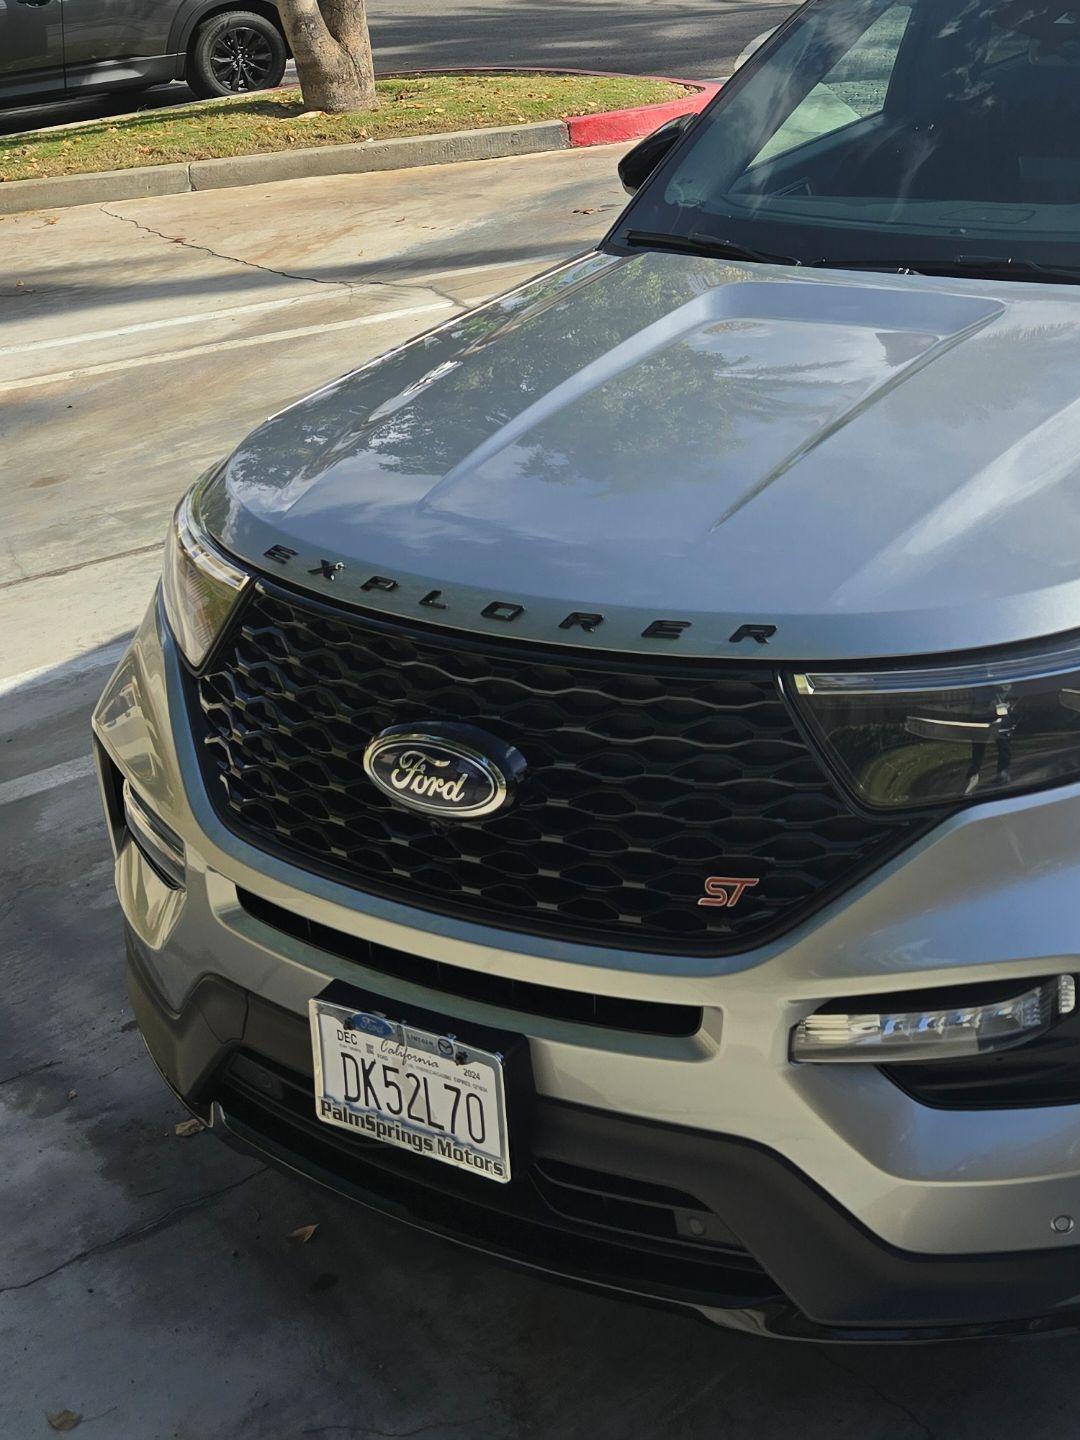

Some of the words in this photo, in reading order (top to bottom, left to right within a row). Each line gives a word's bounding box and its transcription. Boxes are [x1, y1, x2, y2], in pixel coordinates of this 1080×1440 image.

[263, 543, 778, 645] EXPLORER
[390, 749, 469, 802] Ford
[697, 876, 760, 907] ST
[336, 1028, 358, 1046] DEC
[380, 1038, 440, 1068] California
[463, 1067, 482, 1081] 2024
[340, 1051, 486, 1144] DK52L70
[437, 1137, 505, 1177] Motors
